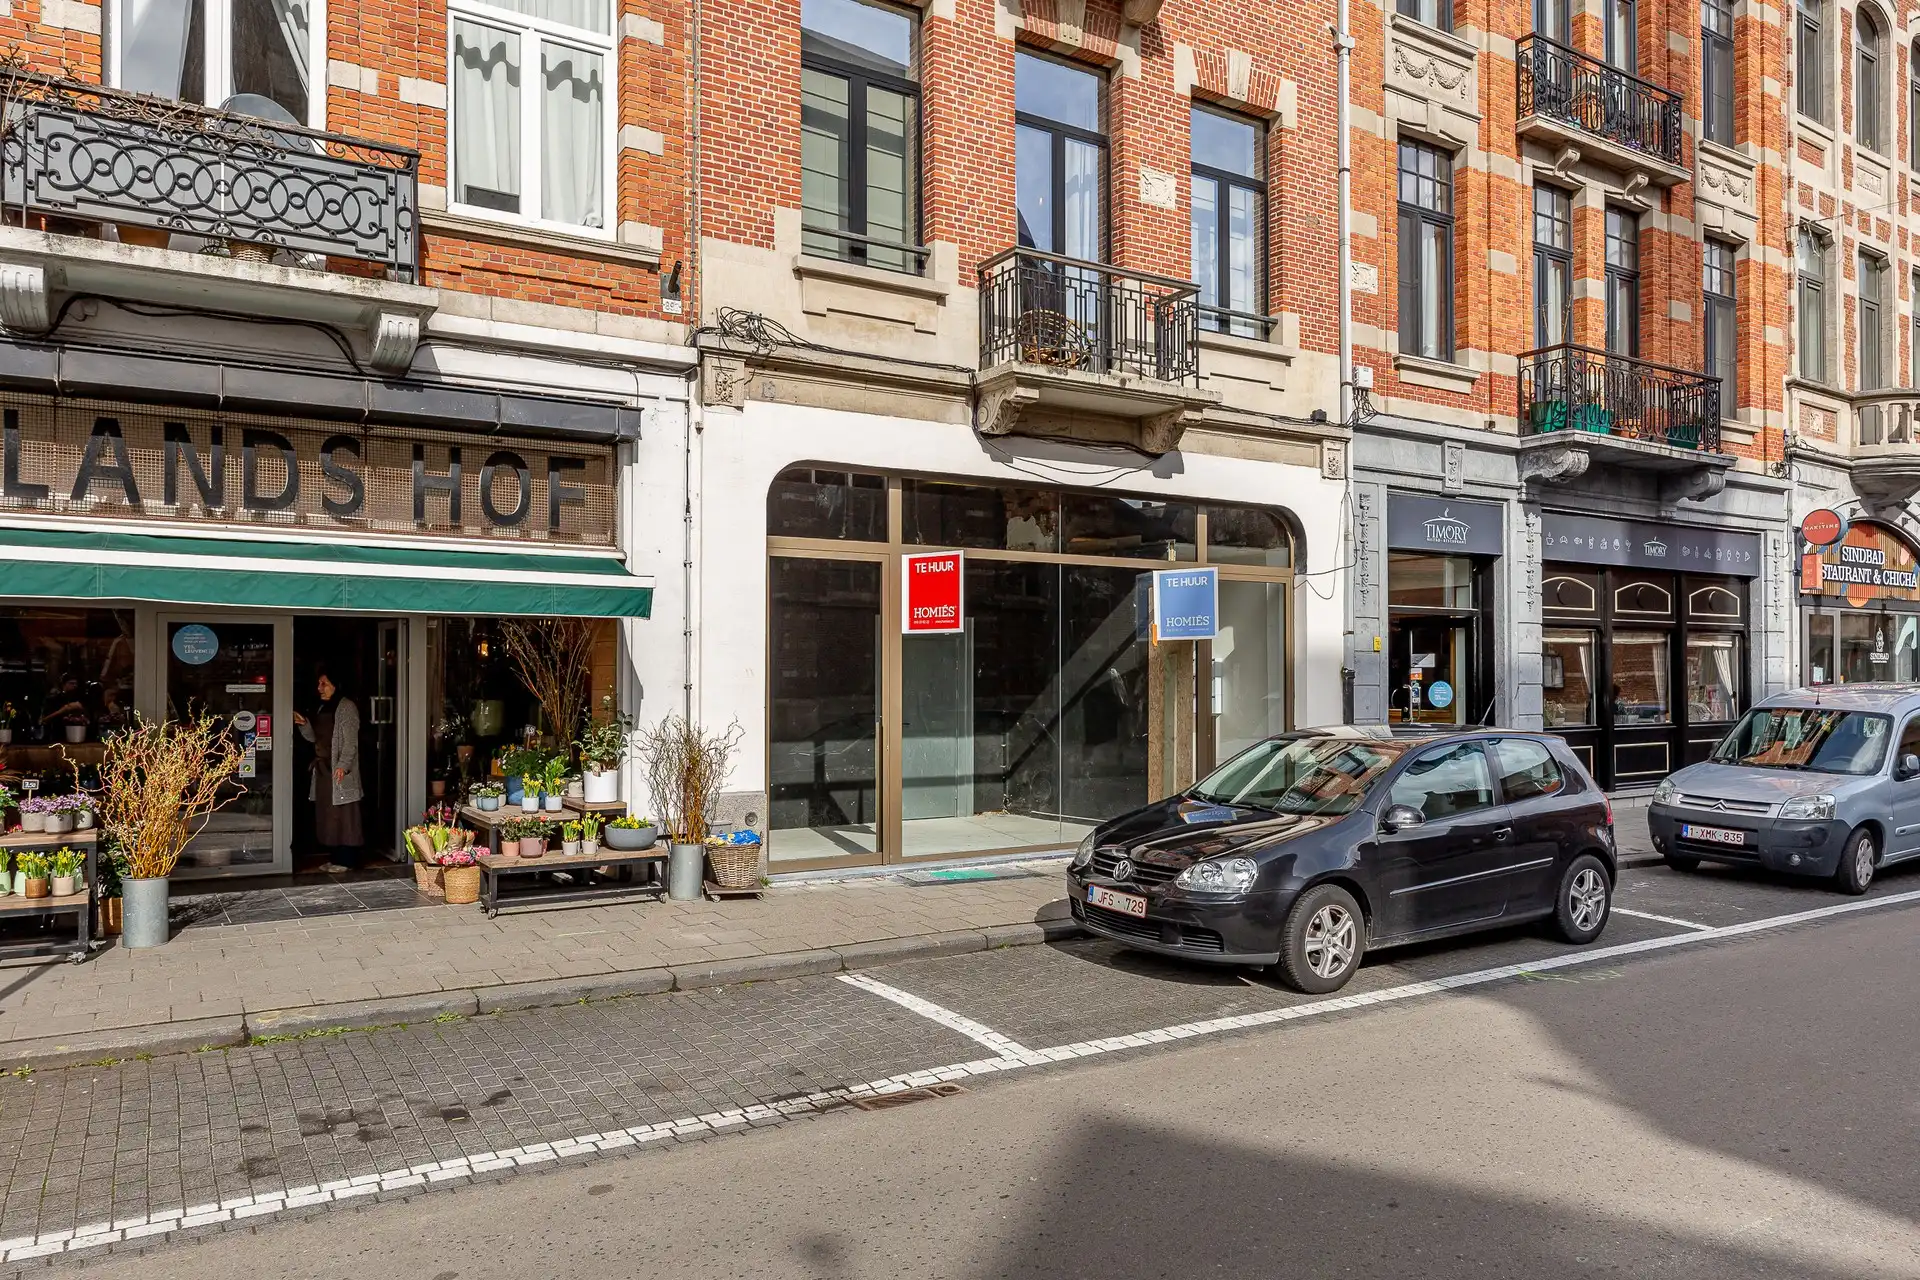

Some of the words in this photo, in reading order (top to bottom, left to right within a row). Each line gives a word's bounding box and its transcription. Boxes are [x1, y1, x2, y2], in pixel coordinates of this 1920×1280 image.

[4, 408, 364, 514] LANDS
[413, 442, 585, 528] HOF
[1424, 523, 1468, 541] TIMORY
[1841, 546, 1885, 565] SINDBAD
[914, 563, 927, 574] TE
[928, 561, 954, 573] HUUR
[1166, 578, 1179, 588] TE
[1180, 576, 1208, 587] HUUR
[1873, 568, 1881, 585] &
[1882, 570, 1917, 588] CHICHA
[913, 604, 955, 618] HOMIÉS
